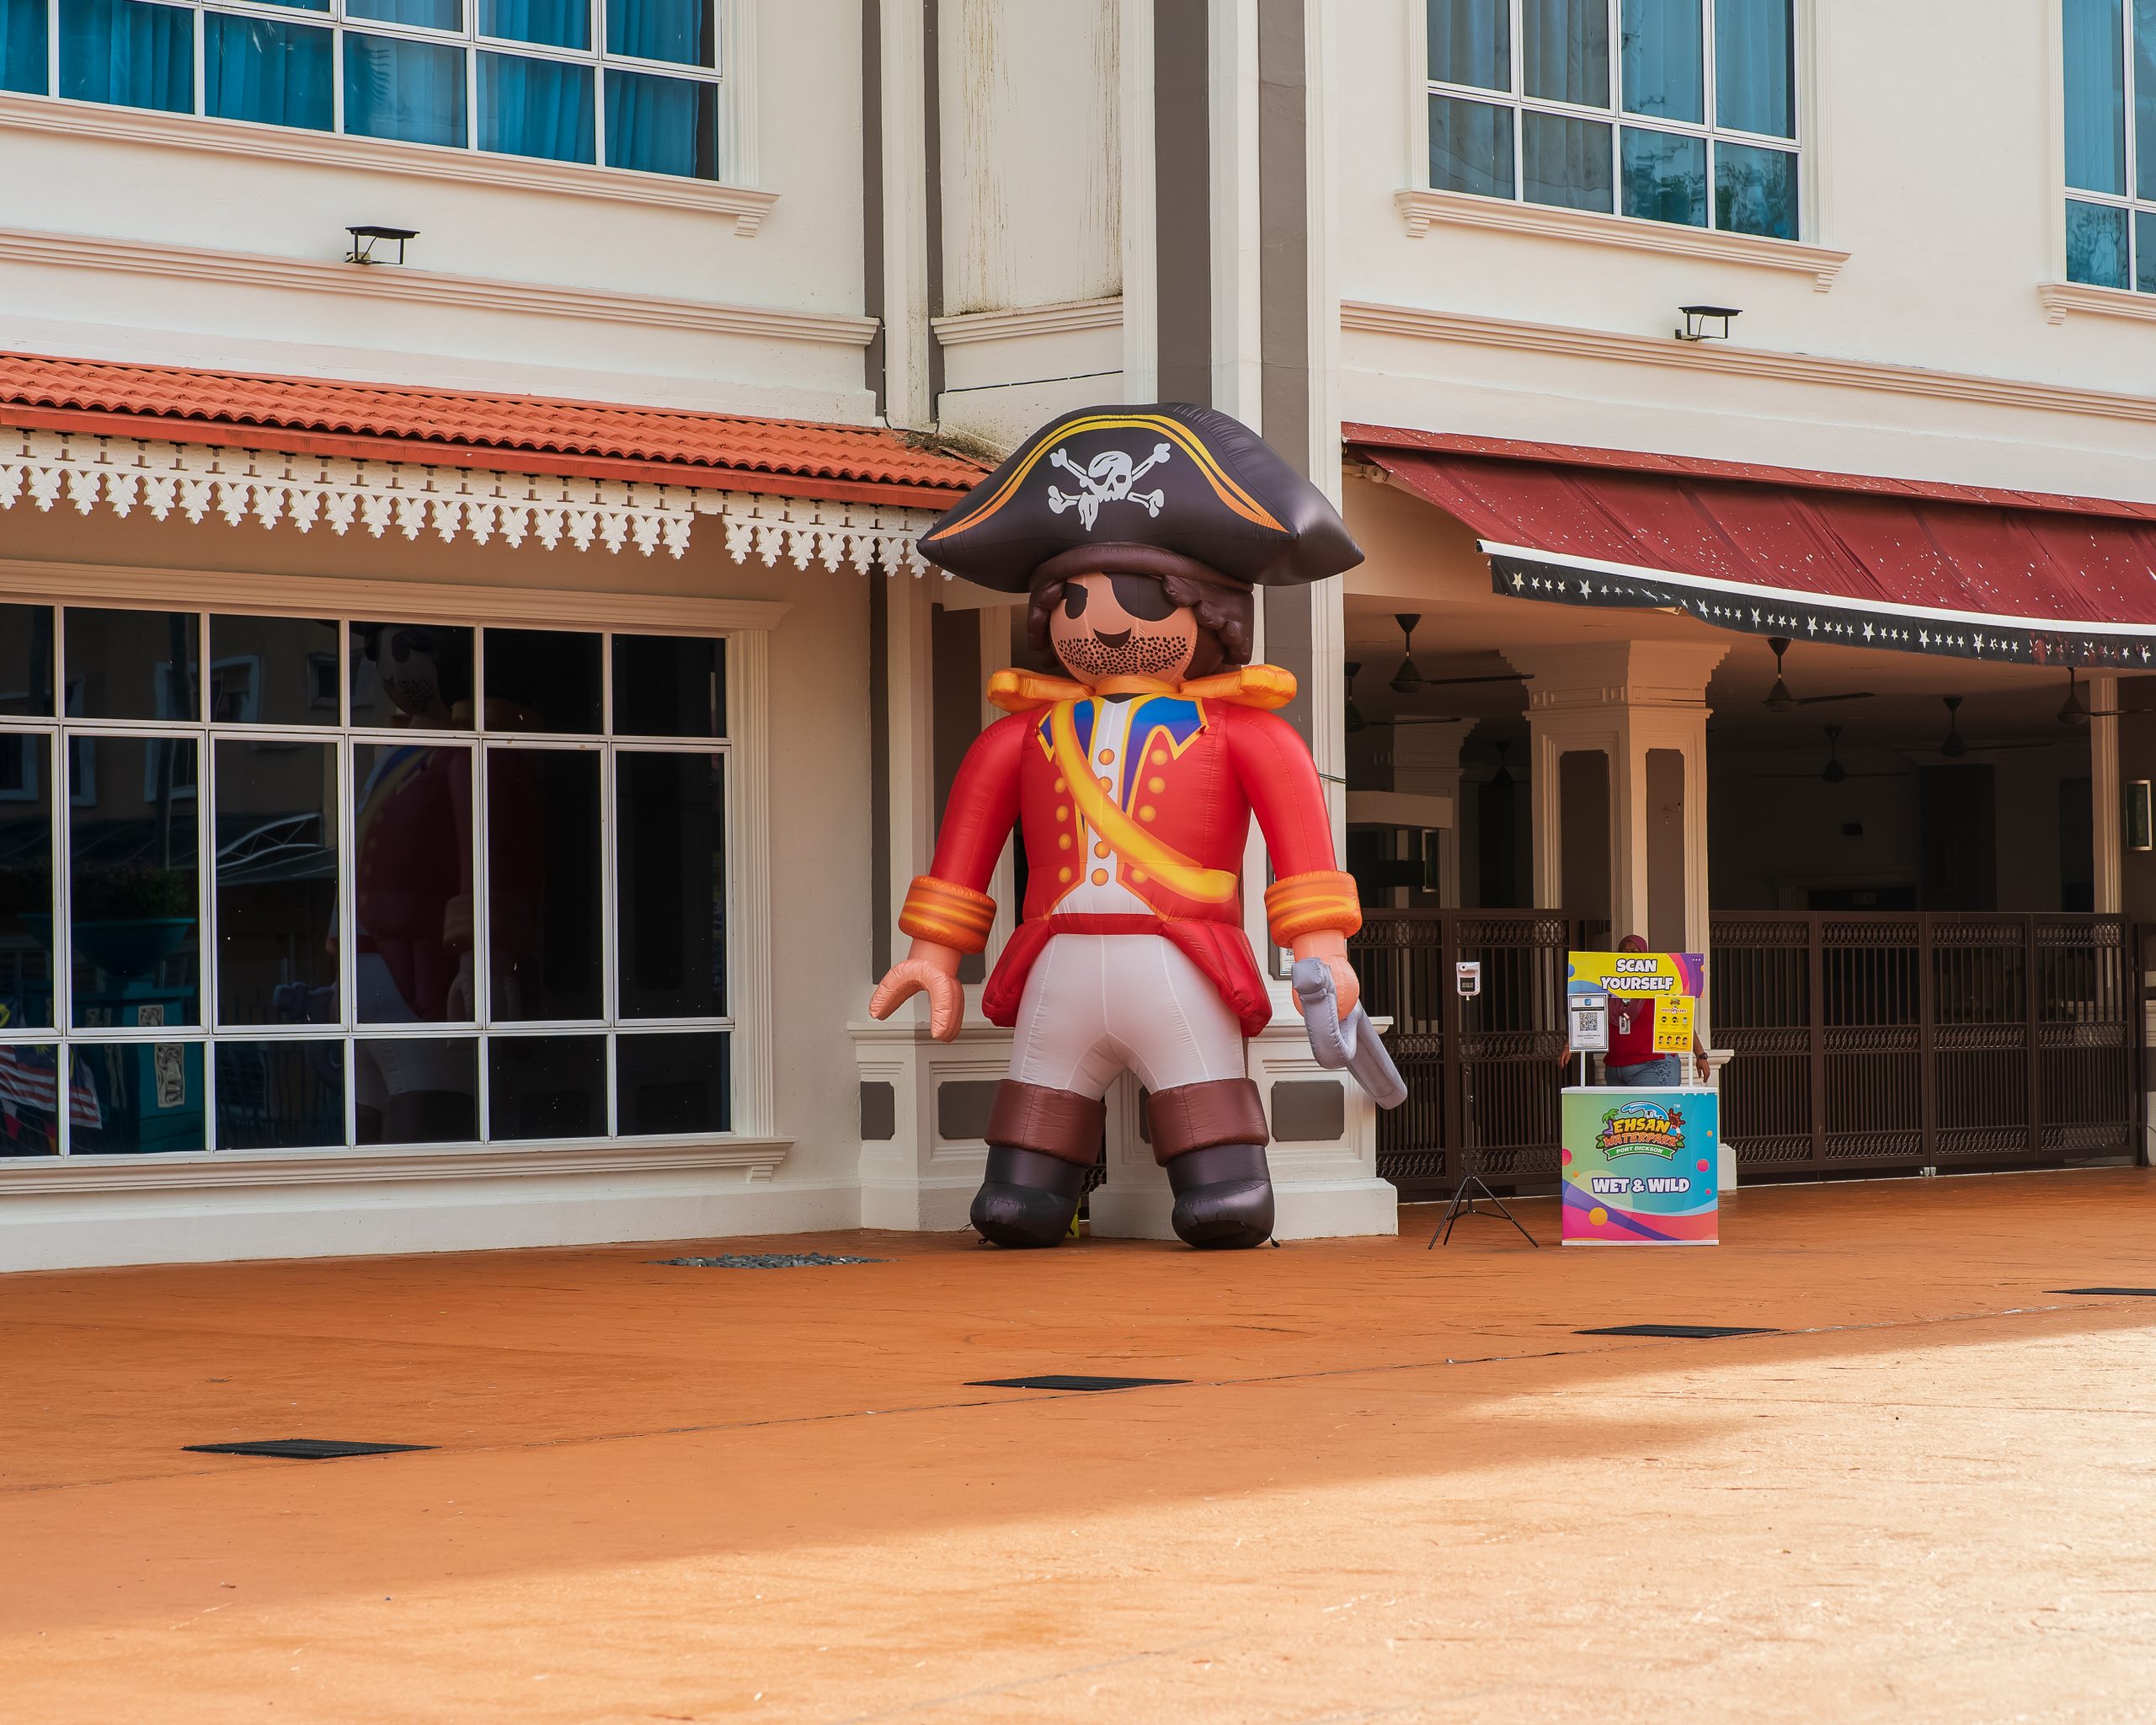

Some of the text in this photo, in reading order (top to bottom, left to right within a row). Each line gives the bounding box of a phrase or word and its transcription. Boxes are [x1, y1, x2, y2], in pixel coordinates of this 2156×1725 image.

[1616, 959, 1657, 973] SCAN
[1600, 976, 1673, 991] YOURSELF
[1613, 1118, 1670, 1134] EHSAN
[1603, 1132, 1678, 1147] WATERPARK
[1634, 1146, 1663, 1154] DICKSON
[1592, 1178, 1690, 1194] WET & WILD
